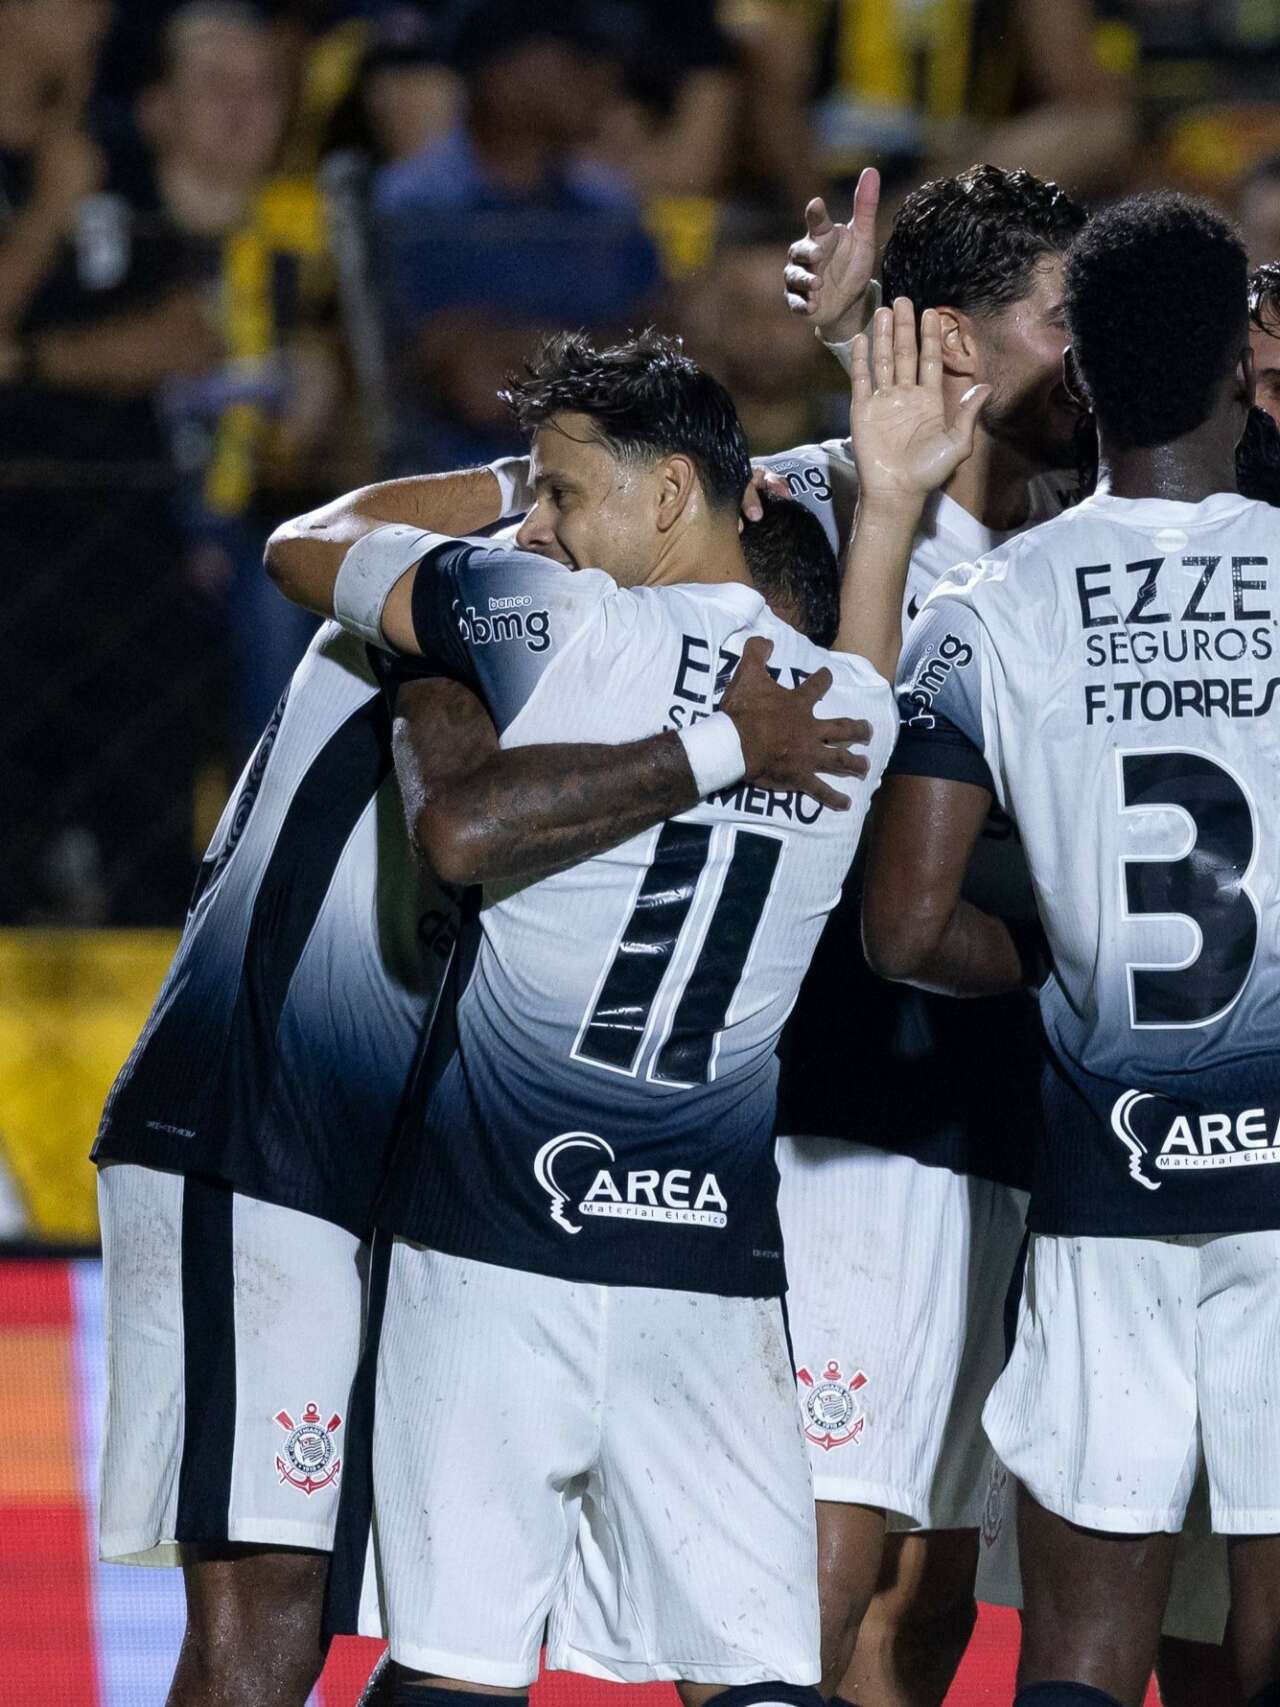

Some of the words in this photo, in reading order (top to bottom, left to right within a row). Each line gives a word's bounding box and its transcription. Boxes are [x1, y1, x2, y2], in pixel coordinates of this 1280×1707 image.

[489, 595, 533, 611] banco
[1075, 556, 1273, 630] EZZE
[466, 607, 551, 653] bmg
[1086, 626, 1273, 667] SEGUROS
[1115, 745, 1260, 1030] 3
[570, 820, 788, 1089] 11
[1159, 1156, 1233, 1168] Material
[583, 1169, 728, 1211] AREA
[583, 1202, 655, 1218] Material
